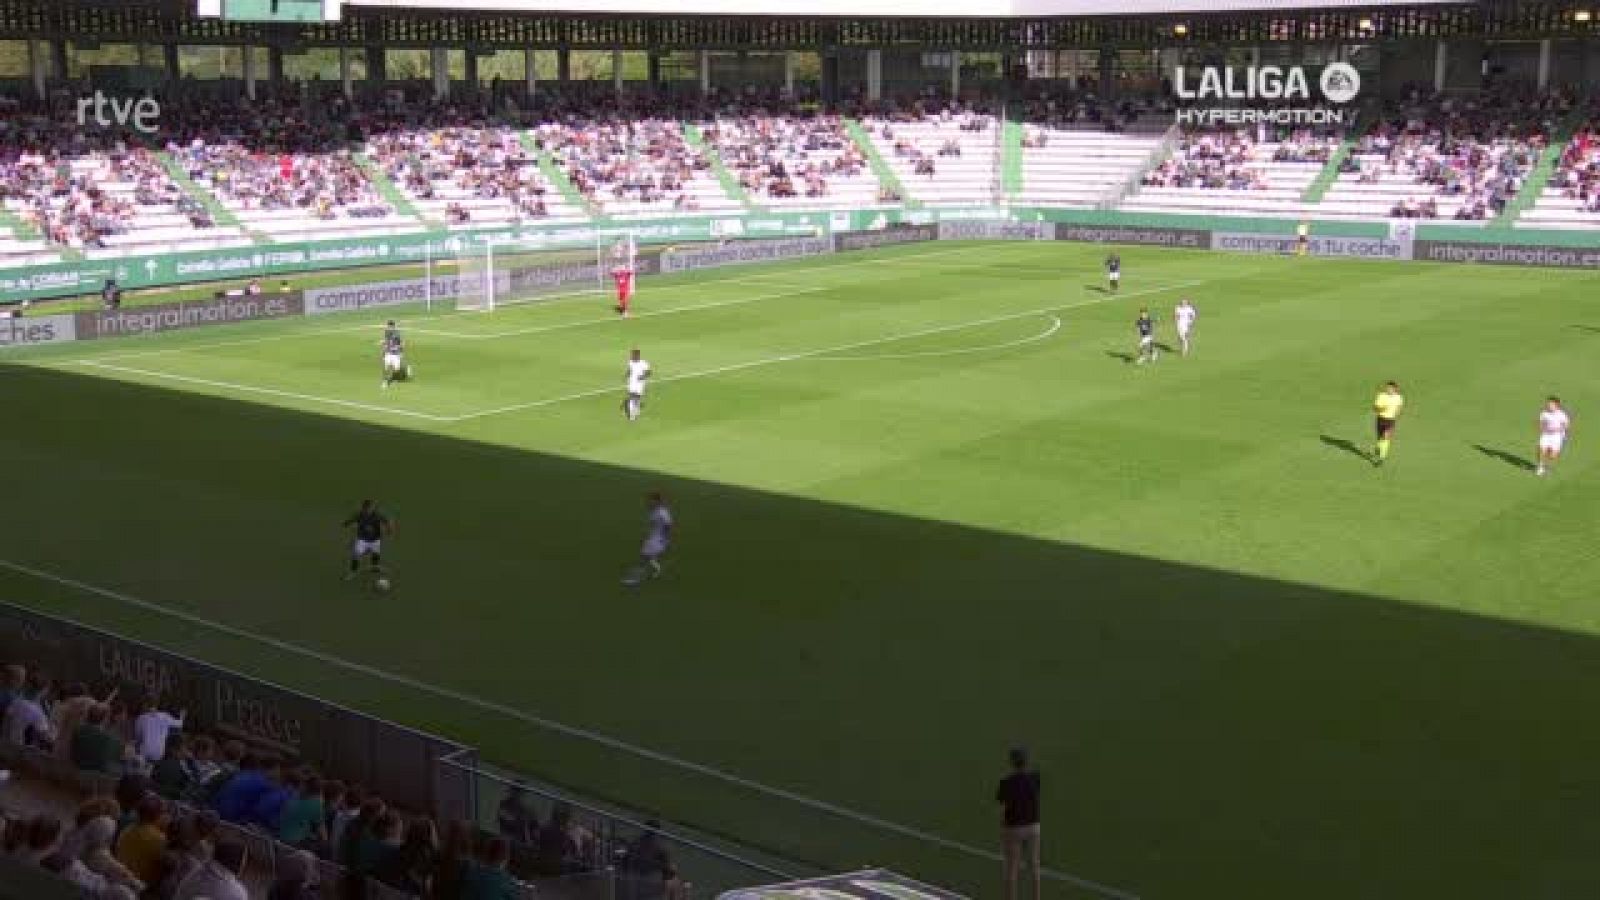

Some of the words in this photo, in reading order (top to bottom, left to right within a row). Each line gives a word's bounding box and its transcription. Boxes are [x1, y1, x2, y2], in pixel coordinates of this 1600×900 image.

[1325, 239, 1344, 254] tu
[1348, 240, 1400, 257] coche
[318, 282, 424, 308] compromos
[97, 295, 287, 333] integralmotion.es
